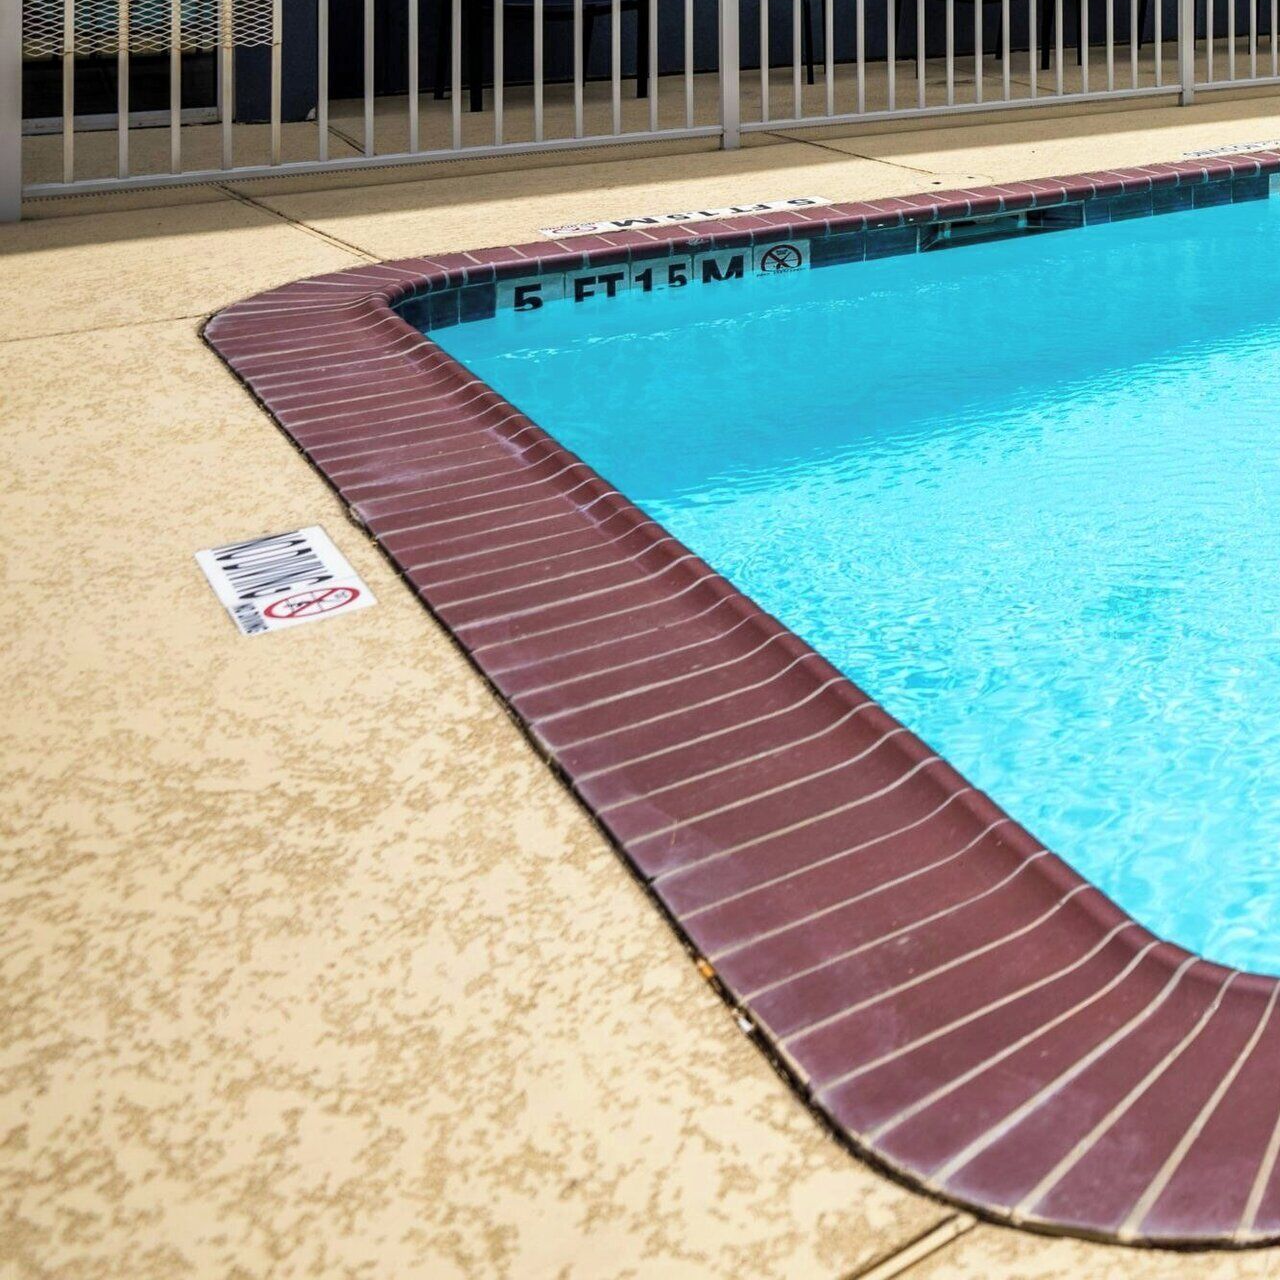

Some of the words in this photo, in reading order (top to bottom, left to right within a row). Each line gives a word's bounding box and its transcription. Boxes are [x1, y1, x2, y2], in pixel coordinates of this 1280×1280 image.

[514, 283, 543, 312] 5
[574, 272, 625, 302] FT
[702, 255, 744, 283] M
